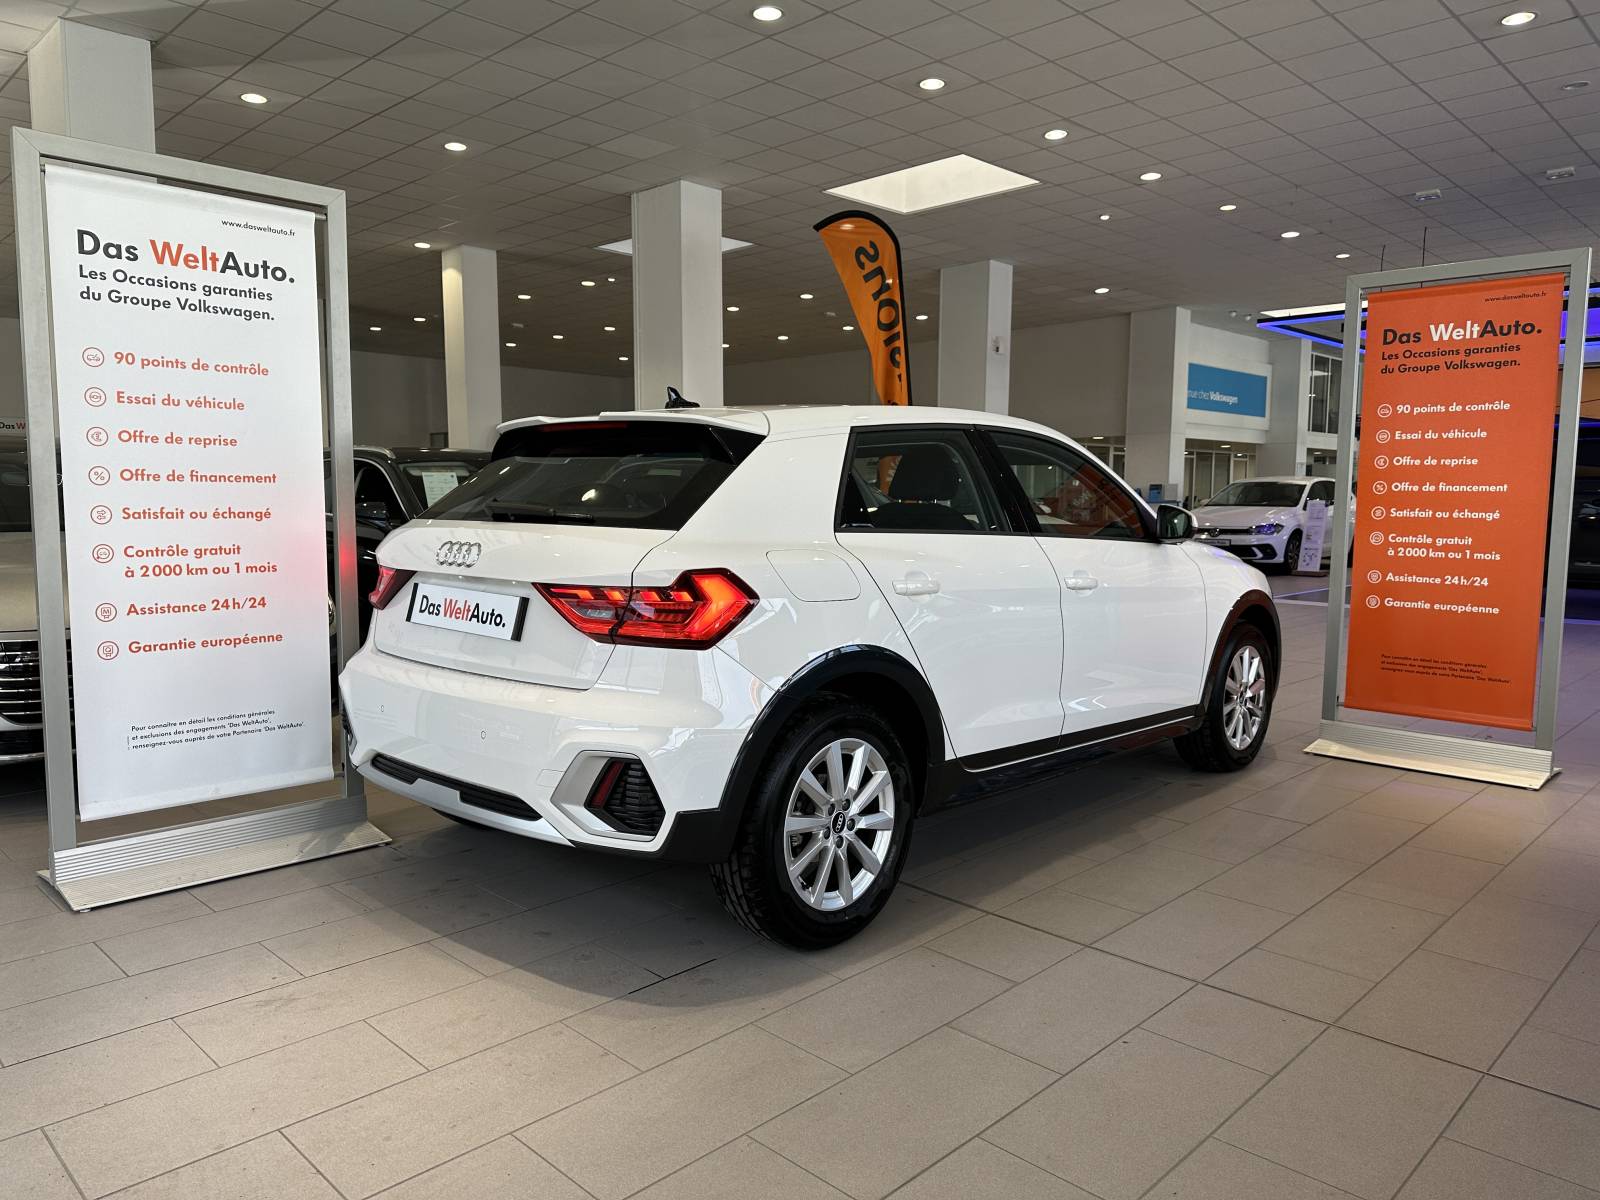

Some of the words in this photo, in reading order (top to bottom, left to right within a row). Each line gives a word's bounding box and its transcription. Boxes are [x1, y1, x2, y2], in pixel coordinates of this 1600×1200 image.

[222, 219, 295, 237] www.dasweltauto.fr
[76, 229, 139, 262] Das
[150, 239, 295, 283] WeltAuto.
[79, 265, 107, 281] Les
[113, 269, 197, 292] Occasions
[202, 283, 273, 301] garanties
[80, 287, 101, 301] du
[108, 290, 171, 311] Groupe
[177, 298, 274, 321] Volkswagen.
[1383, 328, 1422, 345] Das
[1430, 320, 1542, 341] WeltAuto.
[1382, 352, 1399, 361] Les
[1403, 347, 1460, 359] Occasions
[1464, 343, 1520, 356] garanties
[114, 352, 135, 365] 90
[141, 354, 186, 370] points
[192, 358, 209, 372] de
[215, 361, 269, 376] contrôle
[1381, 365, 1394, 374] du
[1398, 363, 1440, 374] Groupe
[1444, 358, 1520, 370] Volkswagen.
[116, 392, 156, 406] Essai
[162, 394, 180, 407] du
[186, 394, 245, 411] véhicule
[1396, 405, 1410, 414] 90
[1413, 404, 1445, 415] points
[1449, 403, 1462, 412] de
[1466, 400, 1510, 411] contrôle
[0, 421, 15, 429] Das
[118, 430, 159, 444] Offre
[165, 433, 183, 445] de
[188, 434, 238, 448] reprise
[1395, 430, 1421, 440] Essai
[1425, 430, 1438, 439] du
[1442, 429, 1487, 439] véhicule
[1393, 456, 1420, 465] Offre
[1424, 456, 1437, 465] de
[1441, 457, 1478, 467] reprise
[120, 469, 161, 483] Offre
[166, 469, 184, 483] de
[190, 470, 276, 484] financement
[1391, 482, 1419, 492] Offre
[1422, 483, 1435, 492] de
[1439, 483, 1508, 492] financement
[122, 508, 184, 520] Satisfait
[190, 510, 208, 519] ou
[212, 507, 272, 522] échangé
[1390, 508, 1432, 518] Satisfait
[1453, 509, 1500, 521] échangé
[1389, 534, 1432, 544] Contrôle
[1435, 536, 1472, 546] gratuit
[124, 545, 188, 558] Contrôle
[194, 544, 241, 559] gratuit
[1387, 548, 1394, 556] à
[1429, 549, 1445, 558] km
[1465, 550, 1470, 559] 1
[1473, 550, 1500, 560] mois
[125, 564, 134, 578] à
[187, 563, 208, 576] km
[212, 565, 229, 575] ou
[234, 563, 240, 574] 1
[246, 562, 278, 574] mois
[1386, 572, 1441, 583] Assistance
[127, 602, 206, 616] Assistance
[419, 595, 441, 617] Das
[443, 598, 506, 628] WeltAuto.
[1384, 598, 1430, 609] Garantie
[1434, 603, 1499, 614] européenne
[129, 638, 196, 654] Garantie
[201, 632, 283, 649] européenne
[217, 712, 246, 721] conditions
[133, 738, 182, 749] renseignez-vous
[185, 735, 205, 744] auprès
[233, 728, 262, 736] Partenaire
[140, 730, 171, 739] exclusions
[186, 724, 226, 735] engagements
